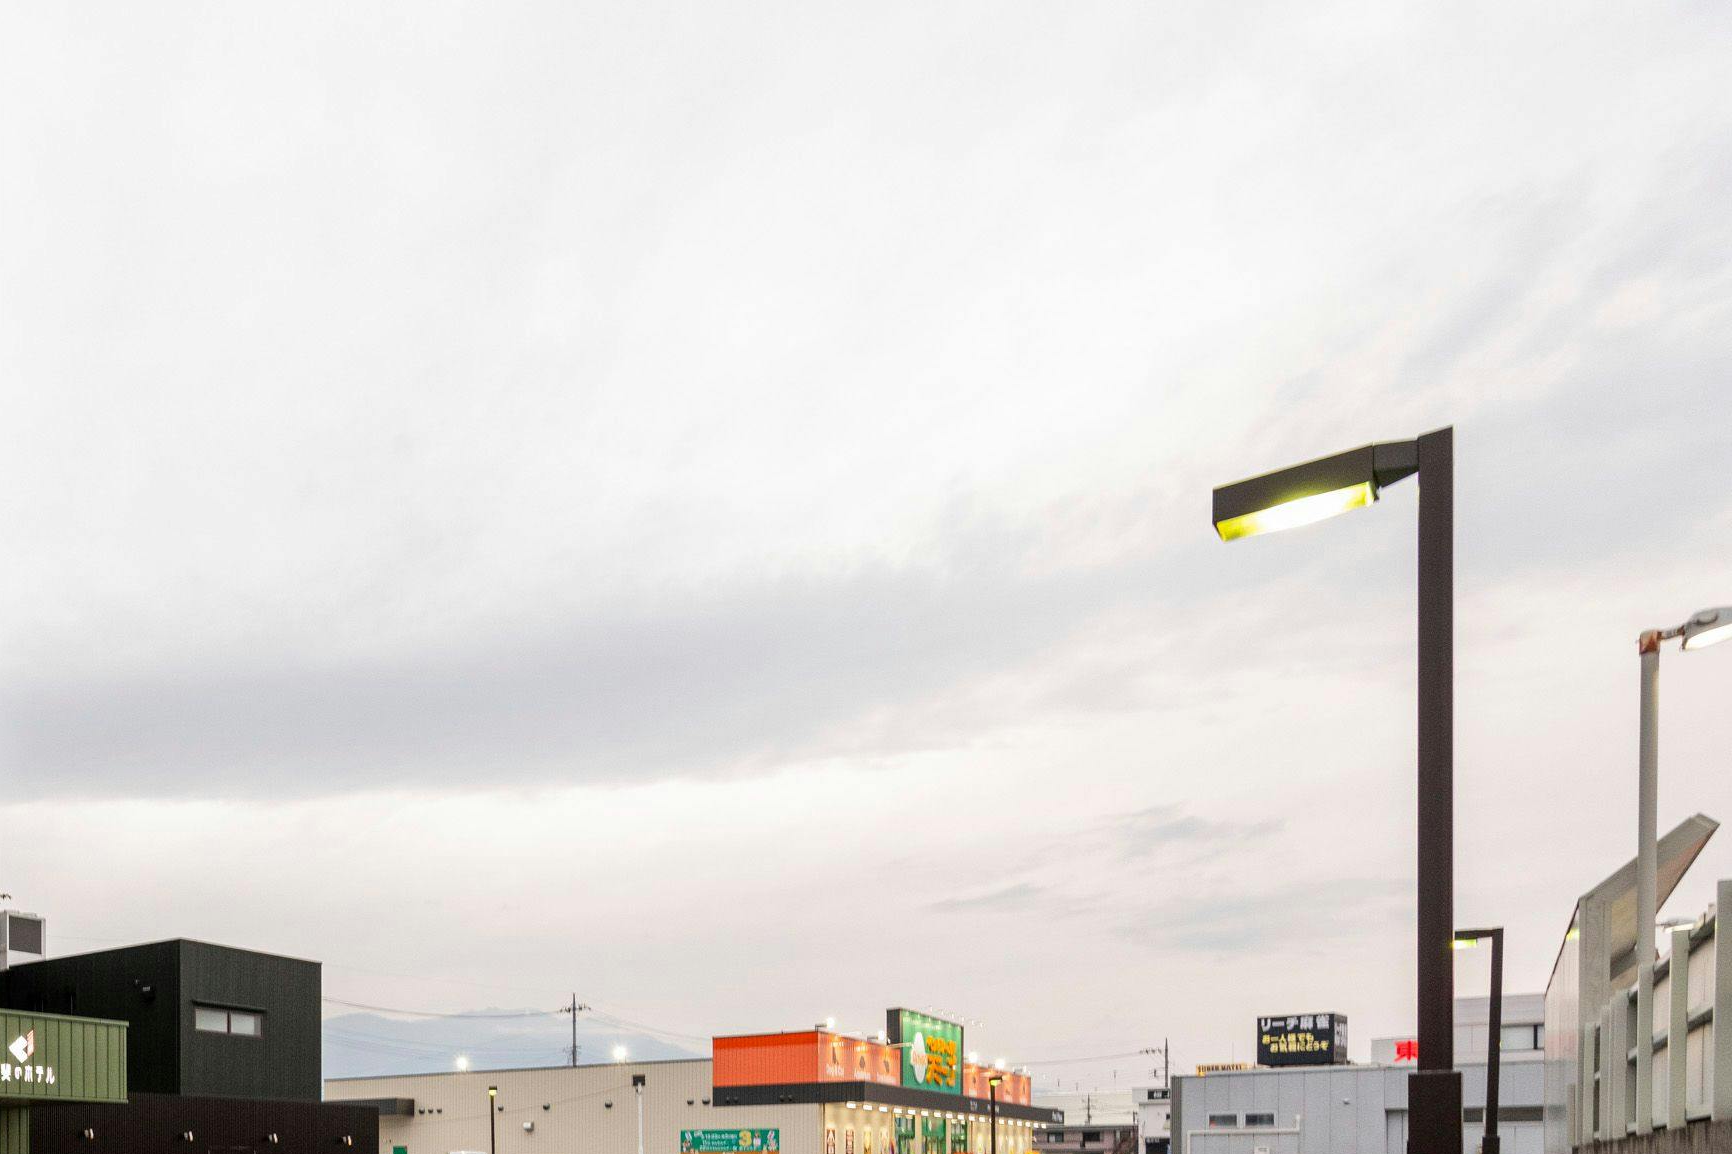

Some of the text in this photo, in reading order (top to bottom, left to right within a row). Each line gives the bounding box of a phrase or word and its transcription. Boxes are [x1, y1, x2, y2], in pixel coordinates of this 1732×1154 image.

[1260, 1015, 1330, 1032] リーチ麻雀
